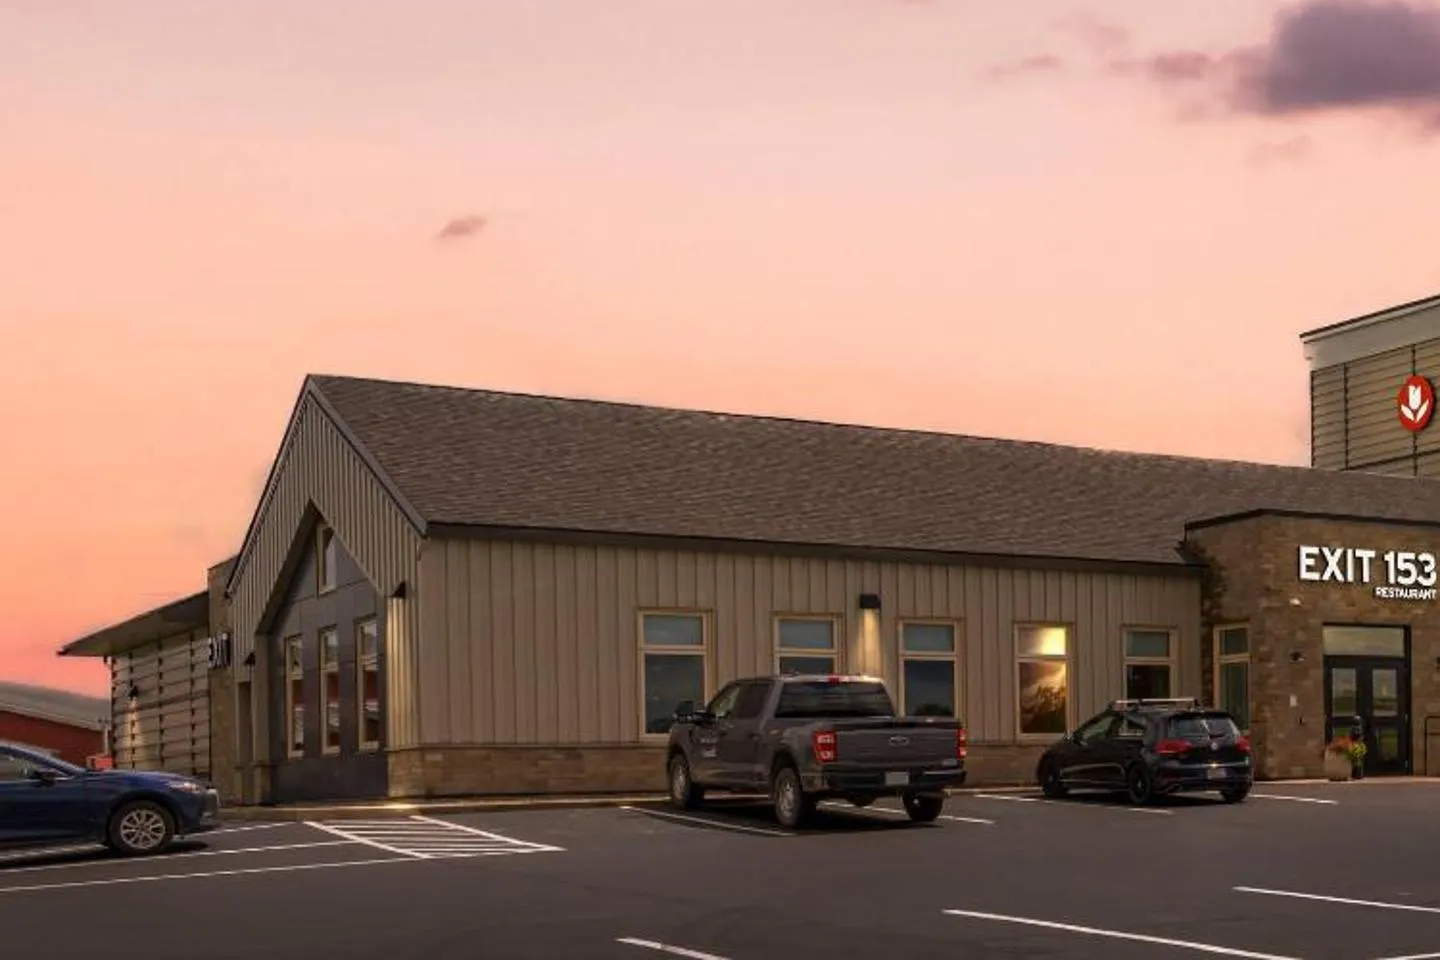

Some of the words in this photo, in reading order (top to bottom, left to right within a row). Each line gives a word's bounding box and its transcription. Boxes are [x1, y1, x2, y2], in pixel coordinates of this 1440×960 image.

[1300, 545, 1376, 583] EXIT
[1384, 550, 1437, 587] 153
[1375, 586, 1437, 600] RESTAURANT
